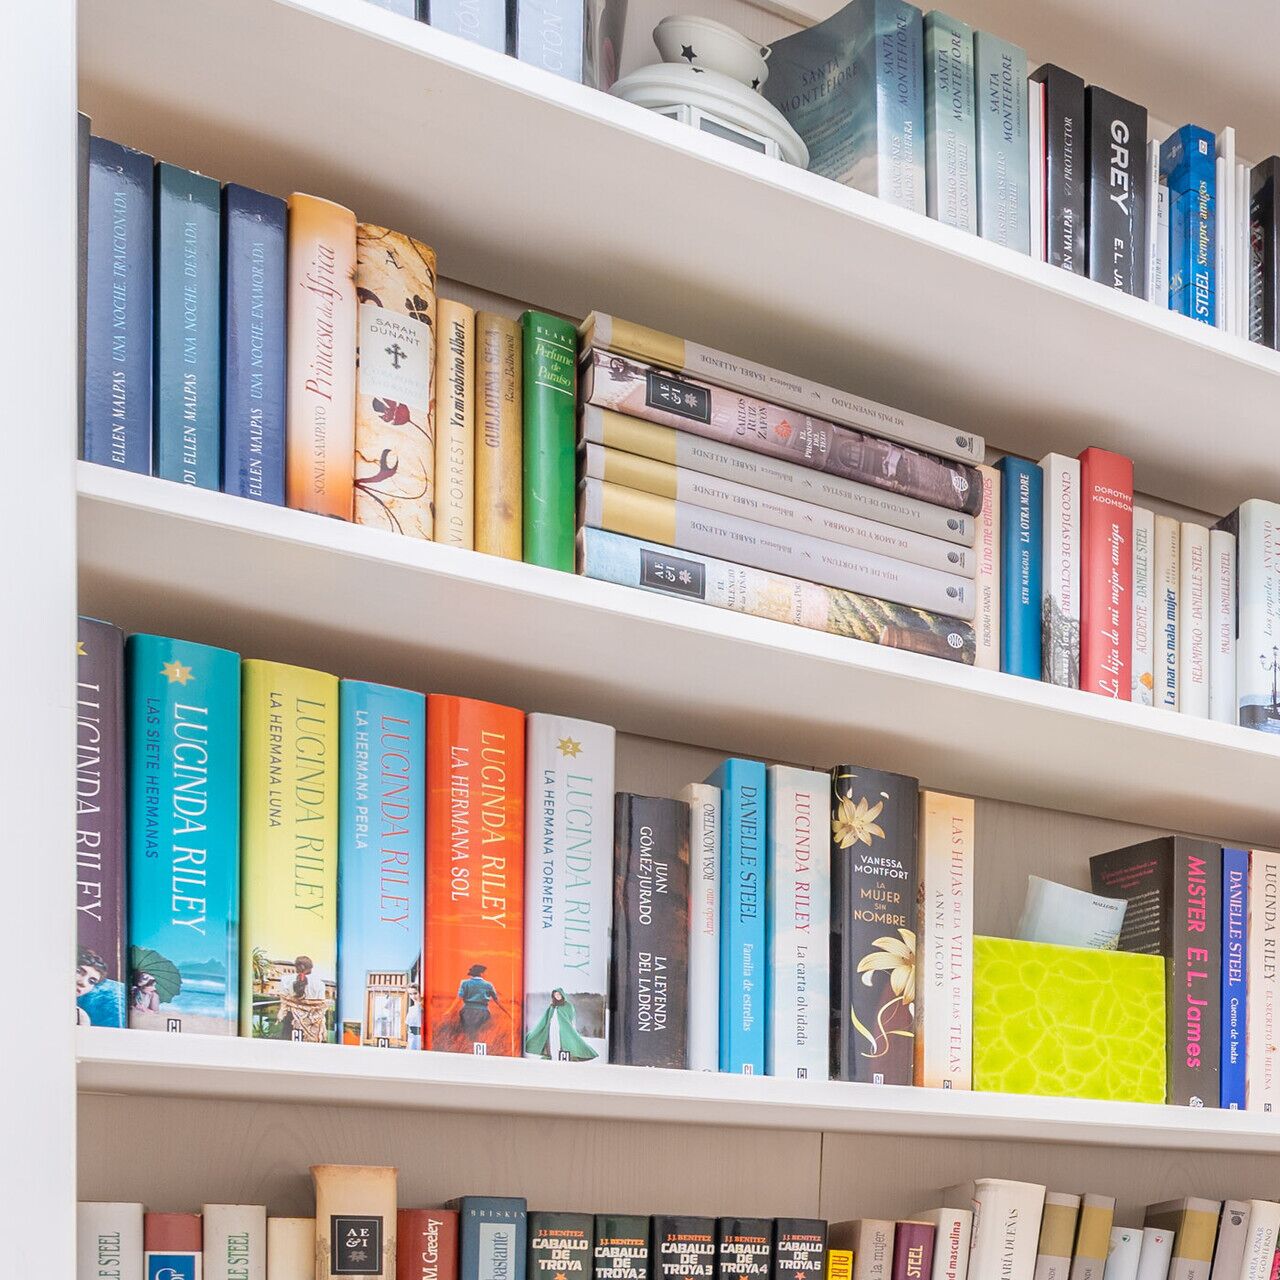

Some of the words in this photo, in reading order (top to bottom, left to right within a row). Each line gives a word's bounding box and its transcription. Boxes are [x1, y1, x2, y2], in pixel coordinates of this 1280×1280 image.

[991, 72, 999, 114] SANTA
[1004, 54, 1012, 144] MONTEFIORE
[1110, 119, 1129, 216] GREY
[1199, 181, 1207, 219] amigos
[113, 192, 126, 278] TRAICIONADA
[1197, 221, 1207, 265] Siempre
[370, 325, 421, 348] DUNANT
[376, 318, 417, 337] SARAH
[112, 337, 125, 362] UNA
[305, 319, 333, 400] Princesa
[321, 305, 333, 320] de
[112, 371, 125, 423] MALPAS
[315, 405, 326, 457] SAMPAYO
[736, 398, 746, 436] CARLOS
[747, 406, 757, 433] RUIZ
[112, 425, 125, 464] ELLEN
[314, 460, 326, 495] SONIA
[1020, 473, 1030, 506] MADRE
[1094, 486, 1133, 502] DOROTHY
[1020, 507, 1030, 530] OTRA
[1092, 495, 1133, 512] KOOMSON
[1021, 531, 1030, 543] LA
[1108, 524, 1124, 565] amiga
[1022, 588, 1030, 605] SETH
[1108, 568, 1124, 604] mejor
[1108, 607, 1119, 626] mi
[1101, 630, 1119, 645] de
[1101, 650, 1123, 675] hija
[269, 692, 282, 708] LA
[1099, 679, 1119, 700] La
[145, 698, 159, 725] LAS
[145, 728, 160, 769] SIETE
[269, 713, 282, 785] HERMANA
[295, 697, 326, 824] LUCINDA
[451, 745, 469, 767] LA
[172, 702, 208, 835] LUCINDA
[481, 729, 506, 845] LUCINDA
[145, 774, 160, 859] HERMANAS
[269, 790, 281, 828] LUNA
[451, 776, 469, 861] HERMANA
[295, 835, 326, 919] RILEY
[639, 826, 653, 925] GÓMEZ-JURADO
[654, 860, 668, 894] JUAN
[854, 864, 909, 881] MONTFORT
[860, 854, 902, 869] VANESSA
[172, 844, 207, 936] RILEY
[451, 867, 469, 902] SOL
[481, 853, 506, 928] RILEY
[860, 888, 900, 904] MUJER
[876, 881, 887, 891] LA
[1187, 855, 1207, 933] MISTER
[854, 911, 906, 927] NOMBRE
[875, 902, 888, 911] SIN
[1230, 870, 1242, 939] DANIELLE
[639, 952, 652, 979] DEL
[655, 956, 667, 974] LA
[1229, 942, 1241, 987] STEEL
[639, 980, 652, 1032] LADRÓN
[654, 975, 667, 1032] LEYENDA
[1230, 998, 1239, 1028] Cuento
[1186, 996, 1208, 1070] James
[1230, 1029, 1237, 1039] de
[1230, 1041, 1238, 1065] hadas
[227, 1232, 249, 1265] STEEL
[421, 1219, 443, 1264] Greeley
[532, 1239, 588, 1250] CABALLO
[552, 1250, 570, 1259] DE
[538, 1260, 582, 1271] TROYA
[907, 1245, 923, 1279] STEEL
